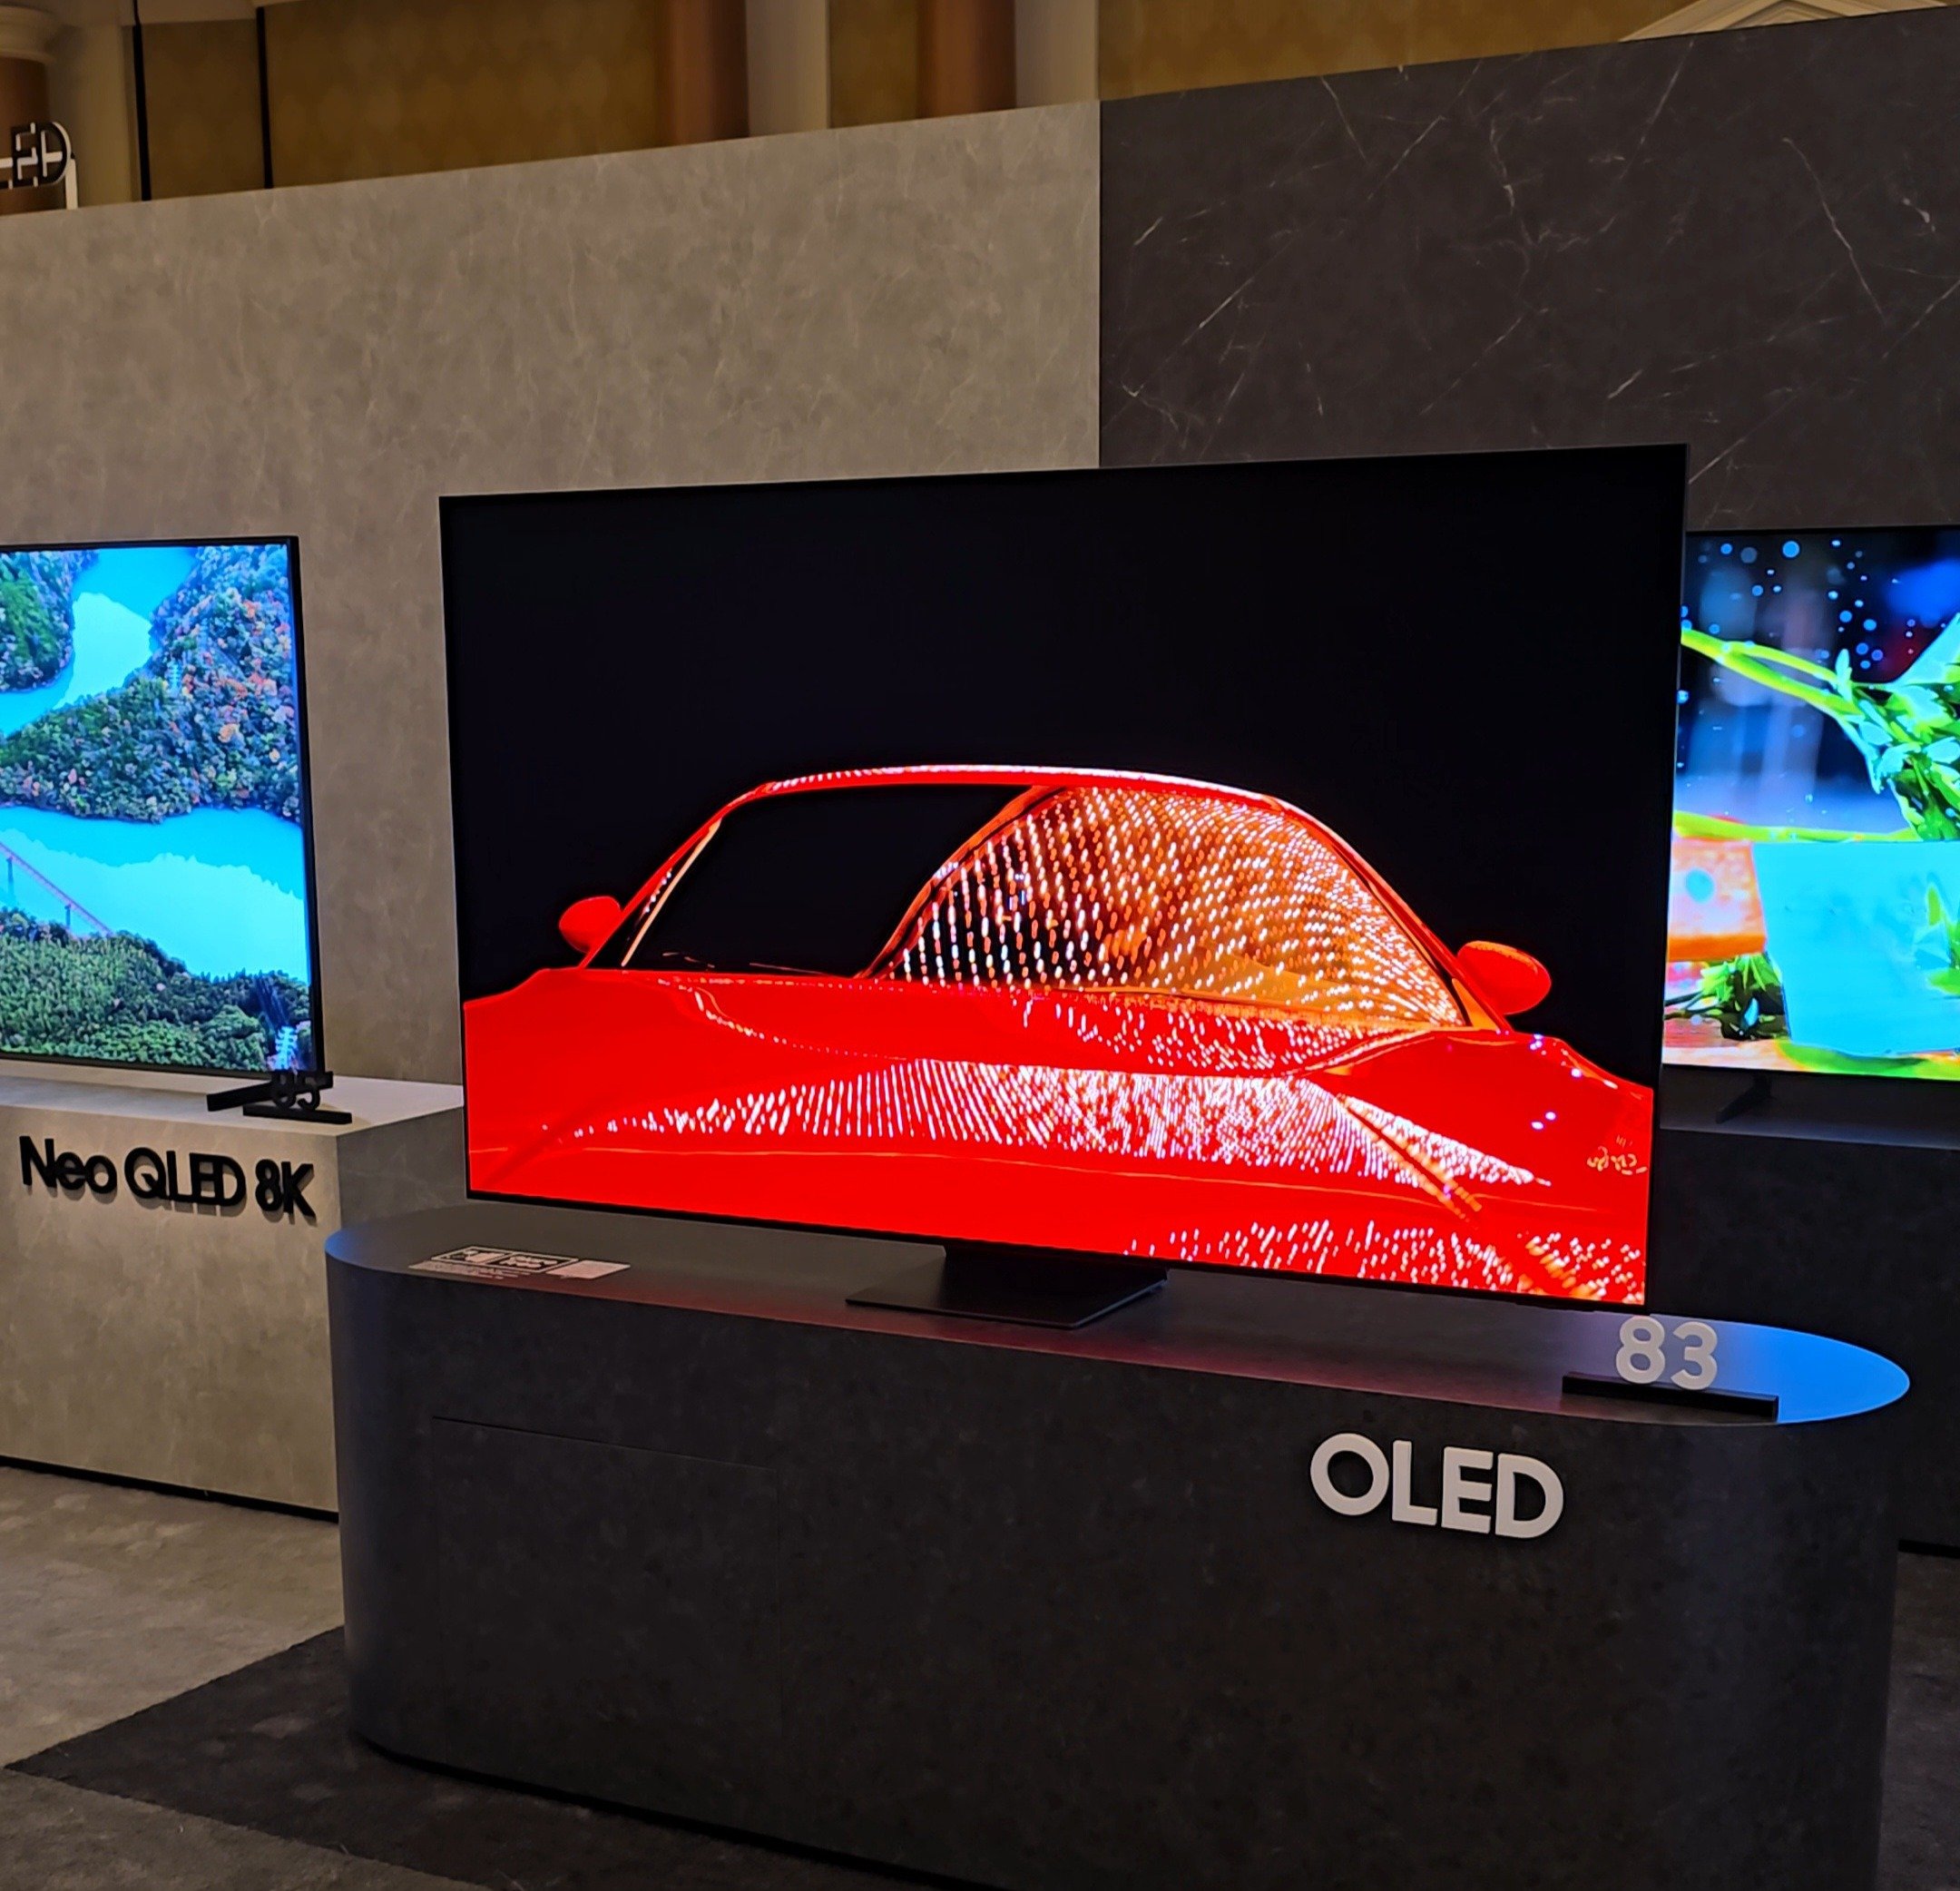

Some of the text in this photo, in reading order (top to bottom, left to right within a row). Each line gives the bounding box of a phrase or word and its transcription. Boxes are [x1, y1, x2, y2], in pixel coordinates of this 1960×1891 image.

[19, 1135, 316, 1219] Neo QLED 8K
[1615, 1315, 1718, 1390] 83
[1310, 1433, 1564, 1539] OLED
